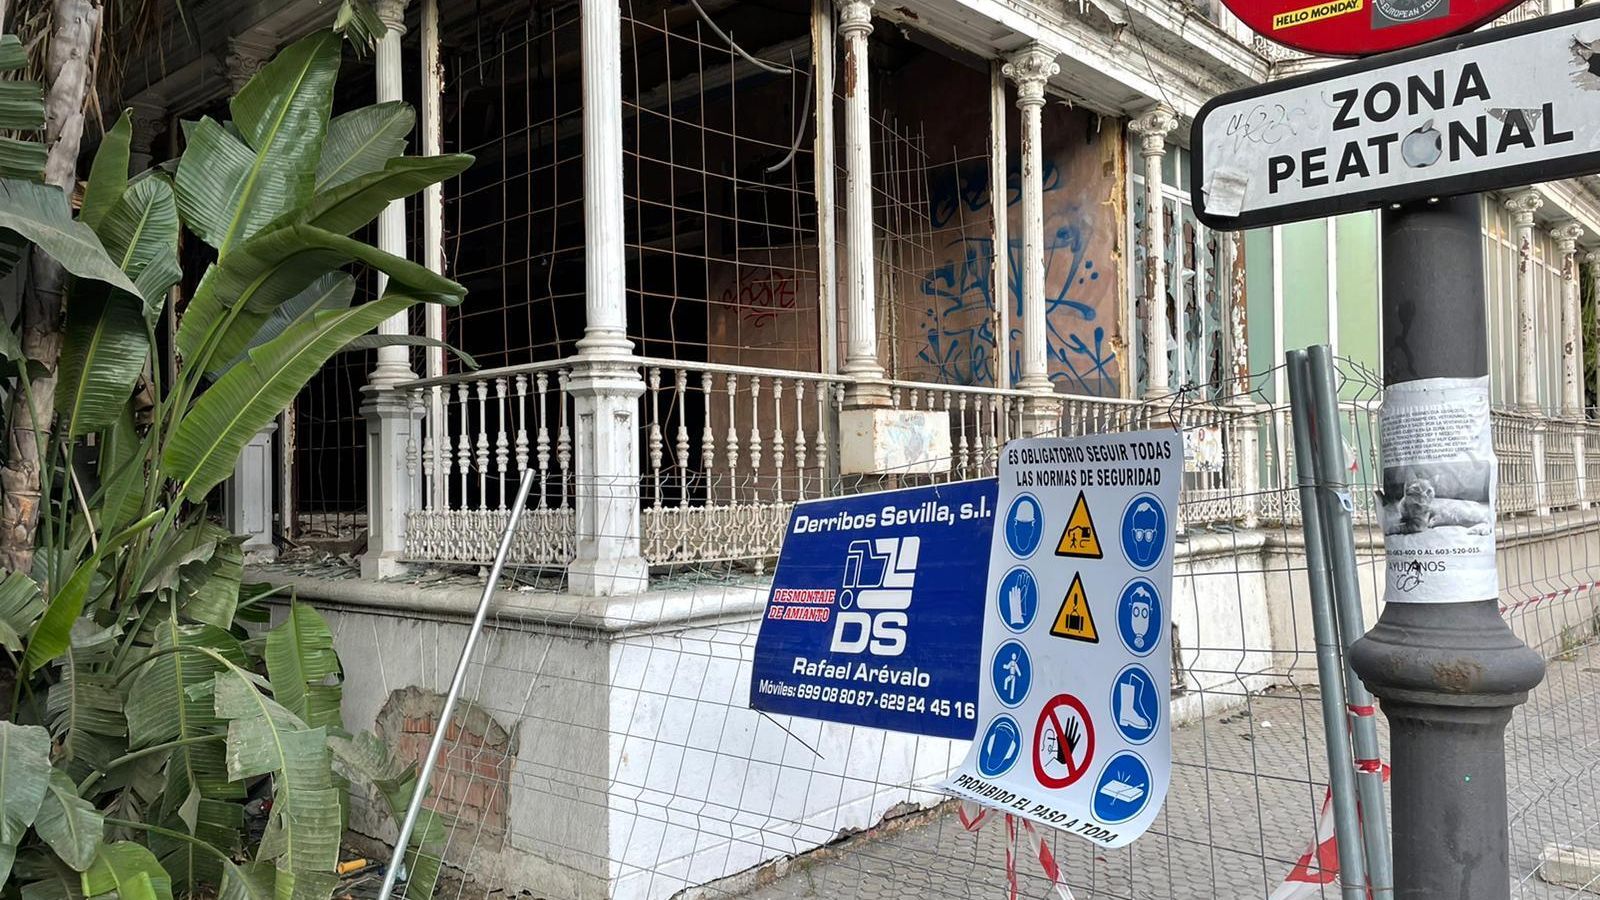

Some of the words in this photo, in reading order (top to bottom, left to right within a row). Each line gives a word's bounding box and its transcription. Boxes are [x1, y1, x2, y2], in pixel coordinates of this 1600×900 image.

[1276, 12, 1308, 26] HELLO
[1381, 3, 1420, 18] EUROPEAN
[1332, 61, 1491, 131] ZONA
[1268, 102, 1574, 194] PEATNAL
[1008, 449, 1019, 465] ES
[1021, 447, 1084, 465] OBLIGATORIO
[1088, 444, 1129, 462] SEGUIR
[1131, 441, 1171, 460] TODAS
[1016, 470, 1034, 487] LAS
[1037, 469, 1077, 487] NORMAS
[1081, 469, 1093, 486] DE
[1097, 467, 1161, 486] SEGURIDAD
[793, 511, 876, 534] Derribos
[881, 501, 955, 526] Sevilla,
[960, 495, 991, 519] s.l.
[773, 588, 836, 604] DESMONTAJE
[768, 606, 784, 619] DE
[784, 607, 831, 622] AMIANTO
[829, 611, 909, 657] DS
[792, 657, 851, 680] Rafael
[853, 663, 931, 688] Arévalo
[759, 679, 797, 698] Móviles:
[797, 684, 820, 700] 699
[821, 686, 837, 702] 08
[839, 689, 856, 705] 80
[907, 696, 926, 713] 24
[930, 699, 951, 717] 45
[954, 702, 976, 720] 16
[953, 774, 1015, 804] PROHIBIDO
[1011, 798, 1030, 811] EL
[1028, 803, 1067, 824] PASO
[1064, 818, 1078, 828] A
[1077, 823, 1120, 844] TODA
